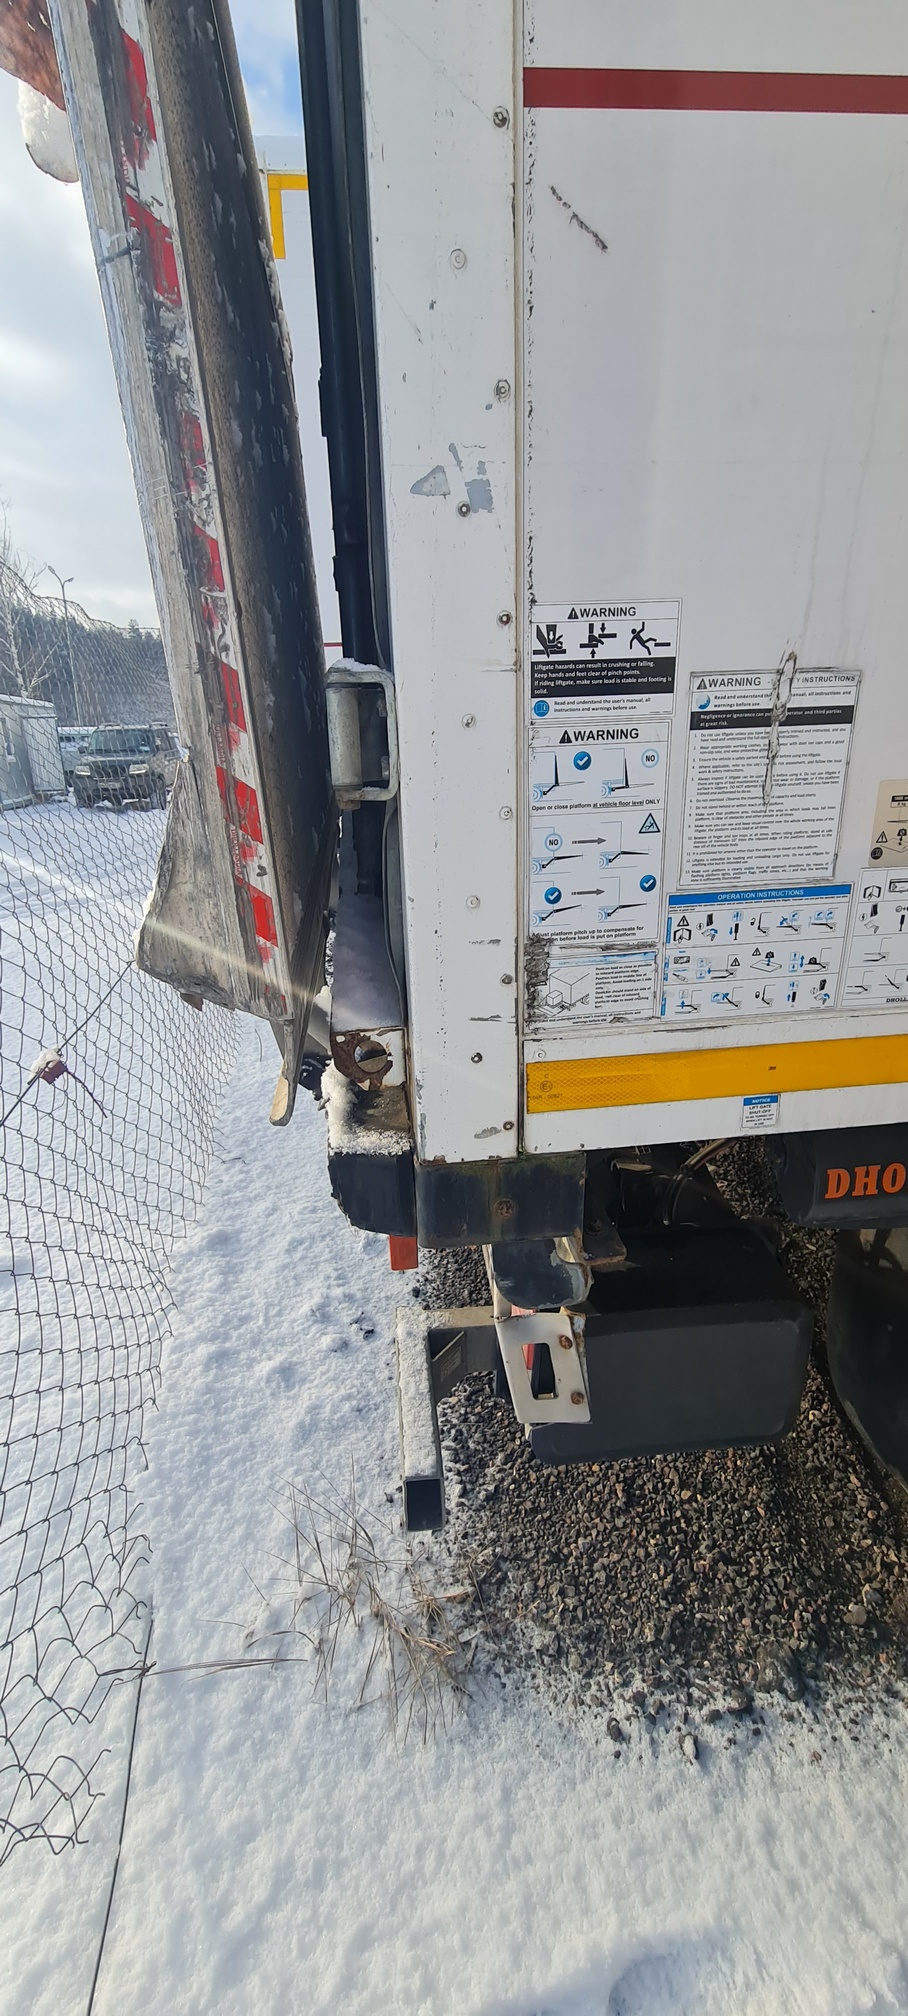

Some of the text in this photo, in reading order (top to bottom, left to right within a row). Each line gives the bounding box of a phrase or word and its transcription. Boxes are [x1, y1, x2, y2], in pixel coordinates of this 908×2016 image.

[580, 607, 636, 618] WARNING
[709, 677, 761, 688] WARNING
[574, 728, 638, 741] WARNING
